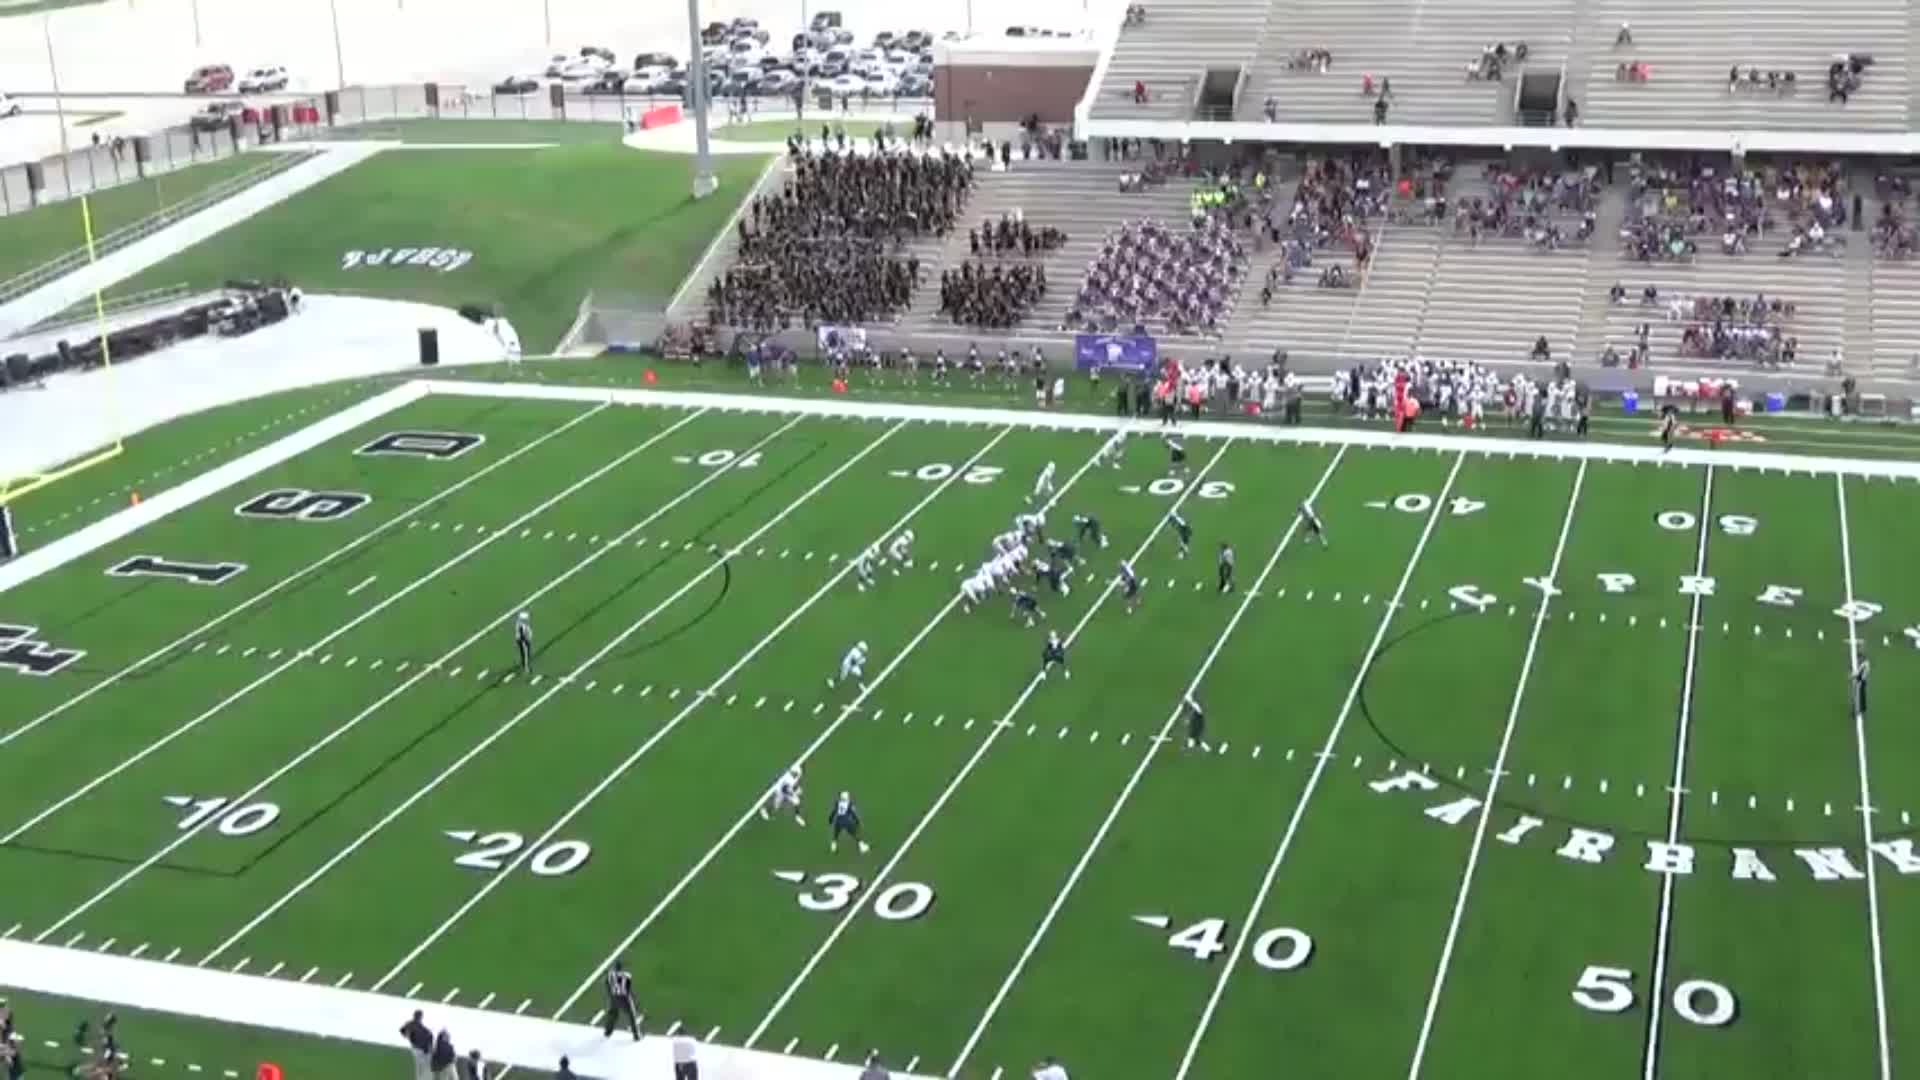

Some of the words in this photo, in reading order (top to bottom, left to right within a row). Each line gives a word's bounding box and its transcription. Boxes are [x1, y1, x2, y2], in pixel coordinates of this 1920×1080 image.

[698, 448, 760, 470] 10
[917, 461, 1005, 484] 20
[1148, 477, 1236, 499] 30
[1394, 493, 1486, 516] 40
[1656, 510, 1758, 536] 50
[173, 795, 281, 836] 10
[453, 831, 593, 877] 20
[798, 872, 936, 921] 30
[1168, 918, 1314, 970] 40
[1572, 965, 1740, 1027] 50
